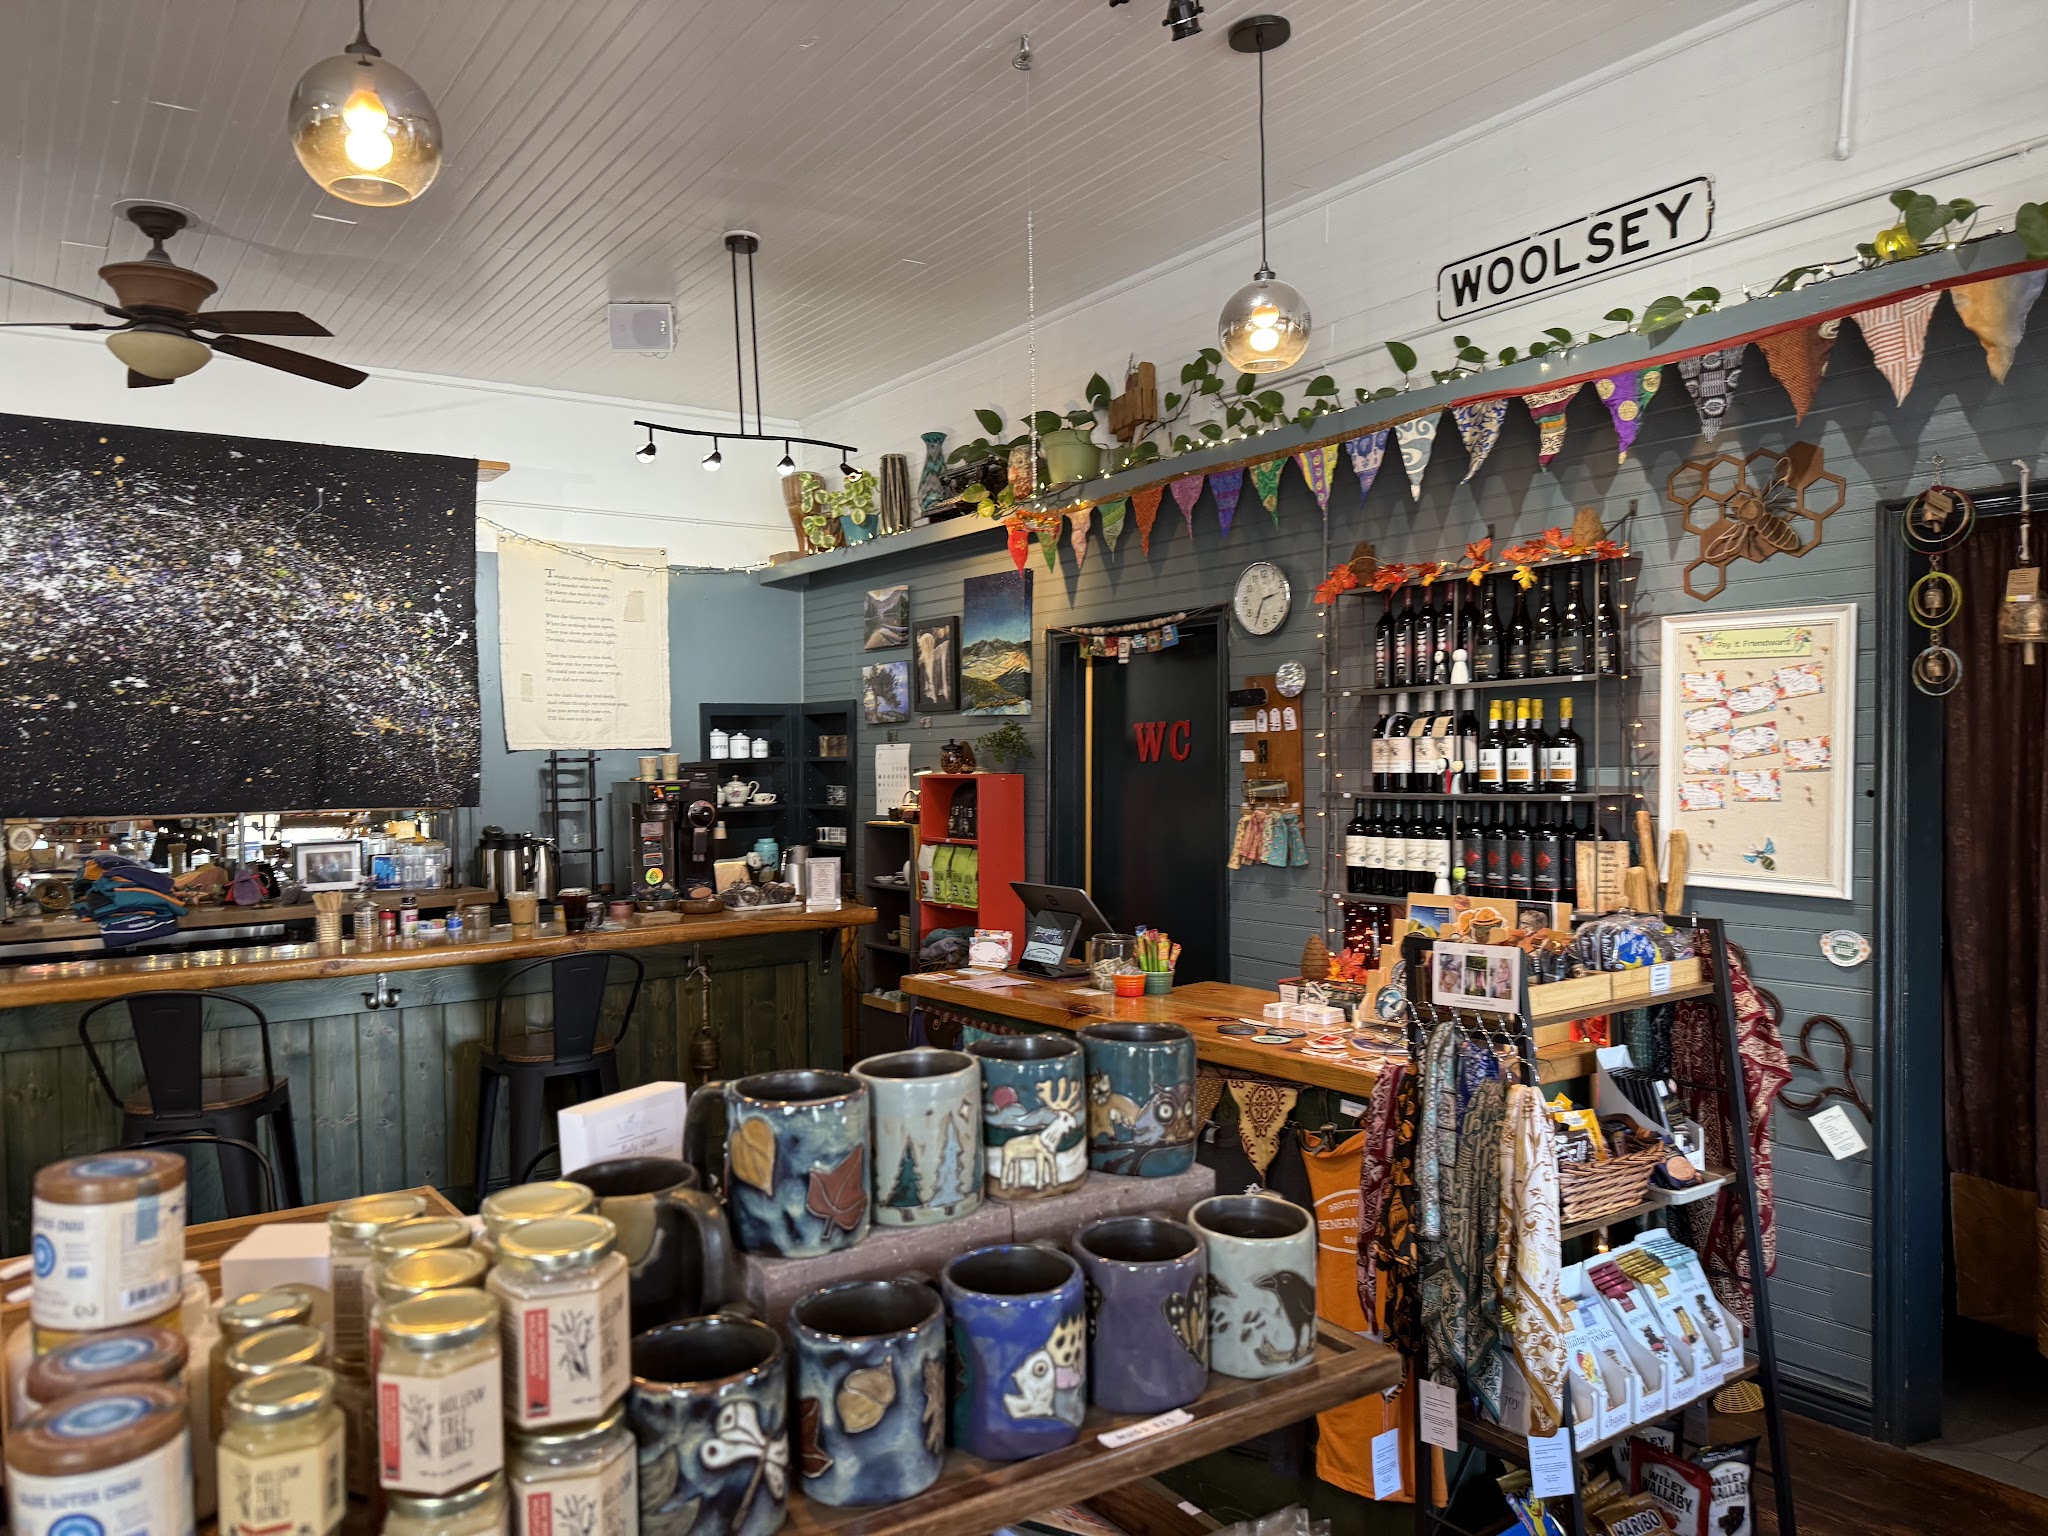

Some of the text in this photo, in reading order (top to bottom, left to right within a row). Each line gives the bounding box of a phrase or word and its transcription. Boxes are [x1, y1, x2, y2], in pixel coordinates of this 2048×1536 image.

[1451, 192, 1693, 307] WOOLSEY
[1133, 719, 1191, 763] WC
[1649, 1469, 1687, 1496] WILEY
[1612, 1509, 1661, 1536] HARIBO
